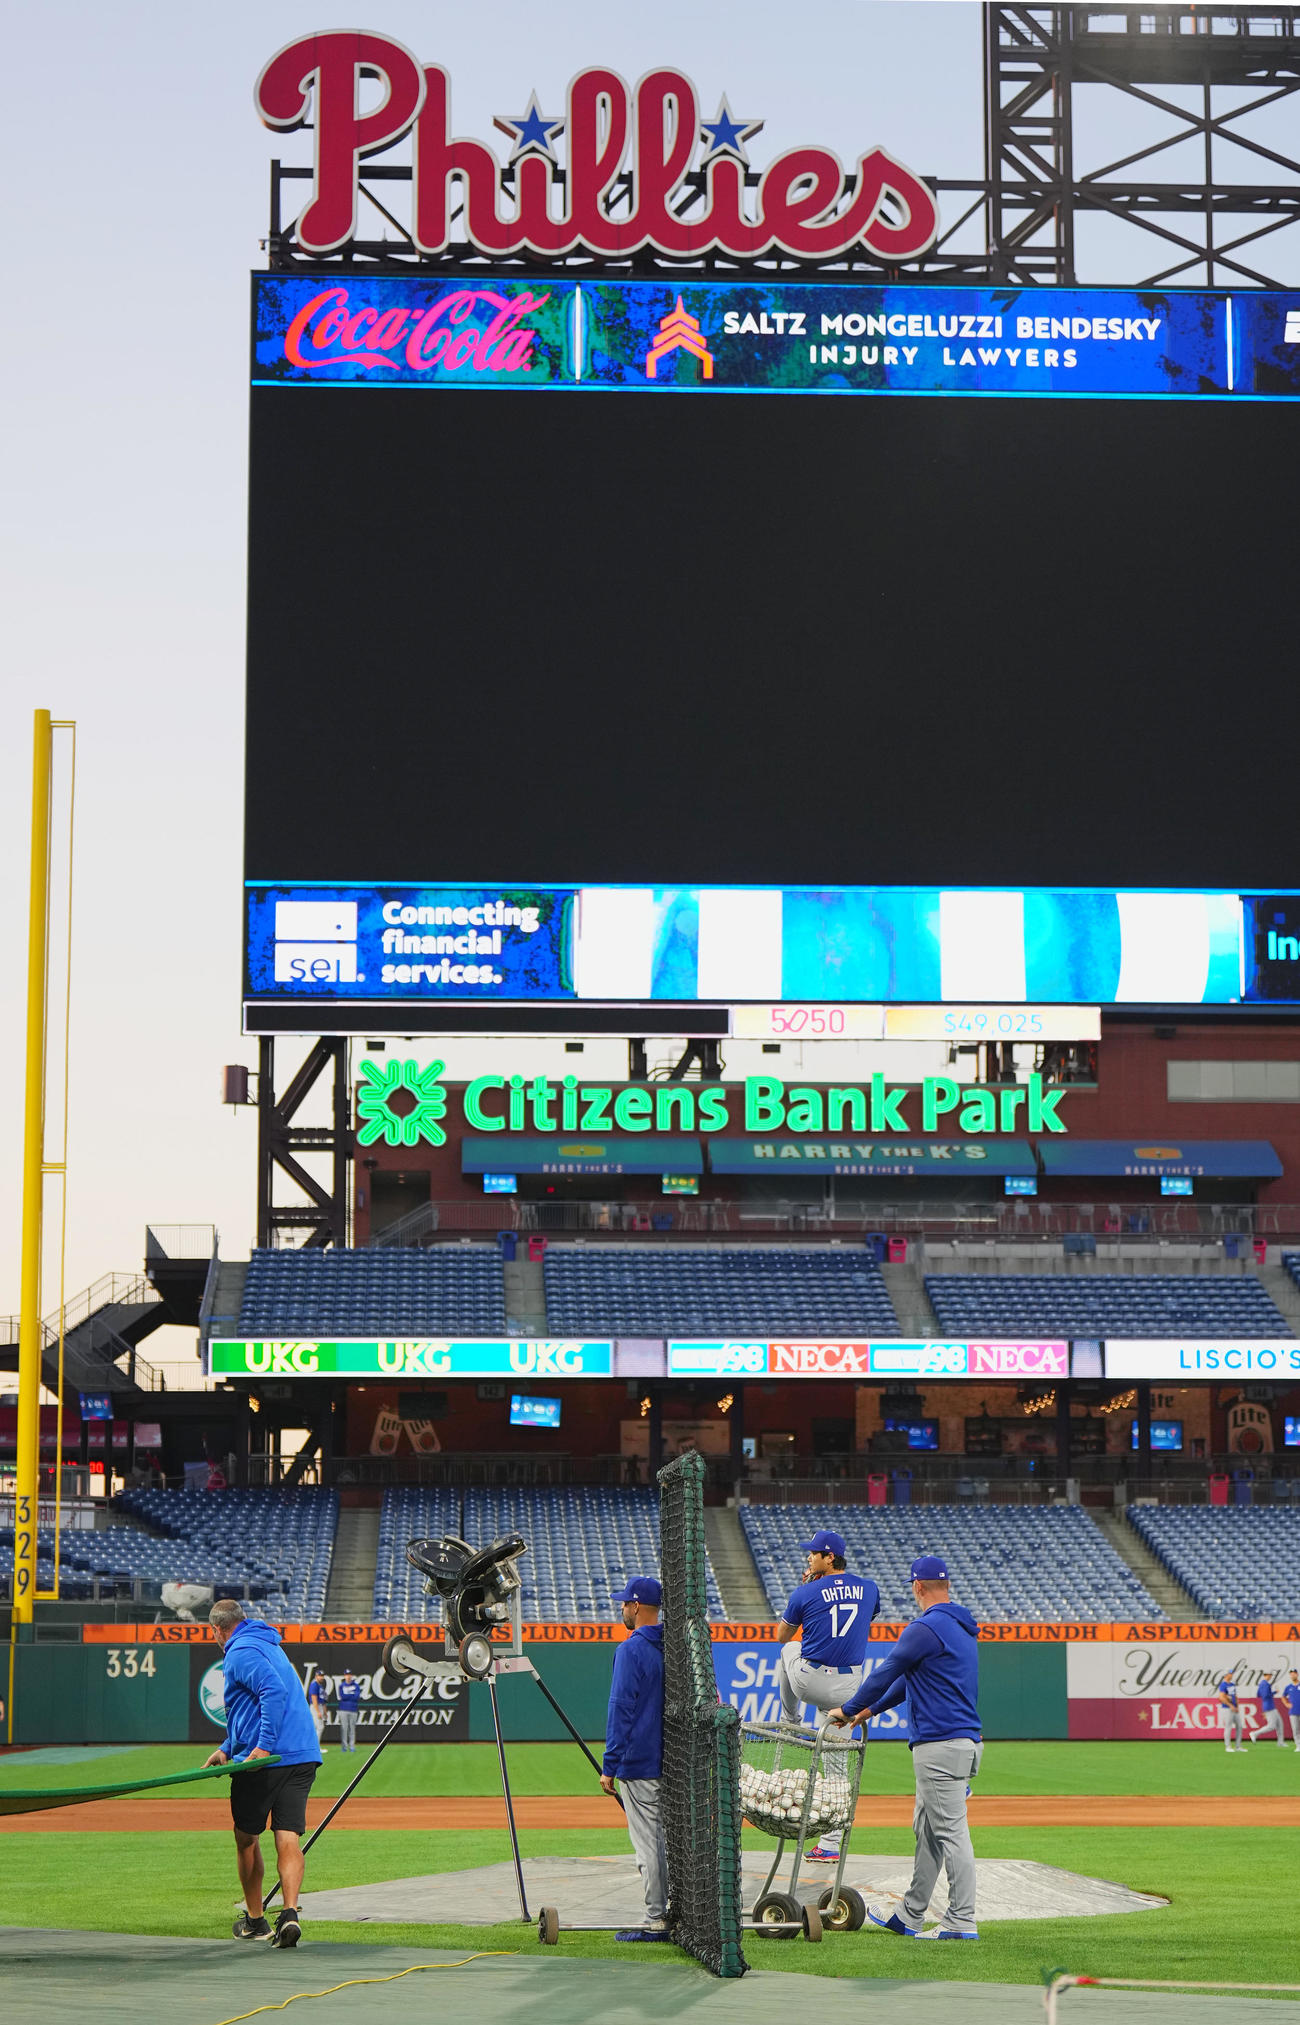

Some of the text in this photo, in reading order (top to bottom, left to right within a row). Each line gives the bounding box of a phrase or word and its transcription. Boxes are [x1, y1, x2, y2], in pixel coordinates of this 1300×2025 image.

[254, 29, 939, 259] Phillies
[284, 288, 550, 371] Coca-Cola
[723, 311, 1162, 341] SALTZ MONGELUZZI BENDESKY
[809, 344, 1078, 368] INJURY LAWYERS
[382, 900, 540, 933] Connecting
[381, 928, 502, 955] financial
[1267, 931, 1300, 960] In
[381, 958, 503, 984] services.
[944, 1013, 1043, 1036] $49,025
[463, 1072, 1068, 1133] Citizens Bank Park
[753, 1144, 988, 1159] HARRY THE K'S
[244, 1342, 319, 1373] UKG
[377, 1342, 452, 1373] UKG
[509, 1342, 584, 1373] UKG
[774, 1346, 867, 1373] NECA
[974, 1346, 1067, 1373] NECA
[1180, 1349, 1300, 1369] LISCIO'S
[1233, 1407, 1267, 1429] Lite
[821, 1586, 864, 1603] OHTANI
[829, 1604, 859, 1638] 17
[977, 1625, 1098, 1640] SPLUNDH
[1126, 1625, 1258, 1640] ASPLUNDH
[106, 1649, 156, 1678] 334
